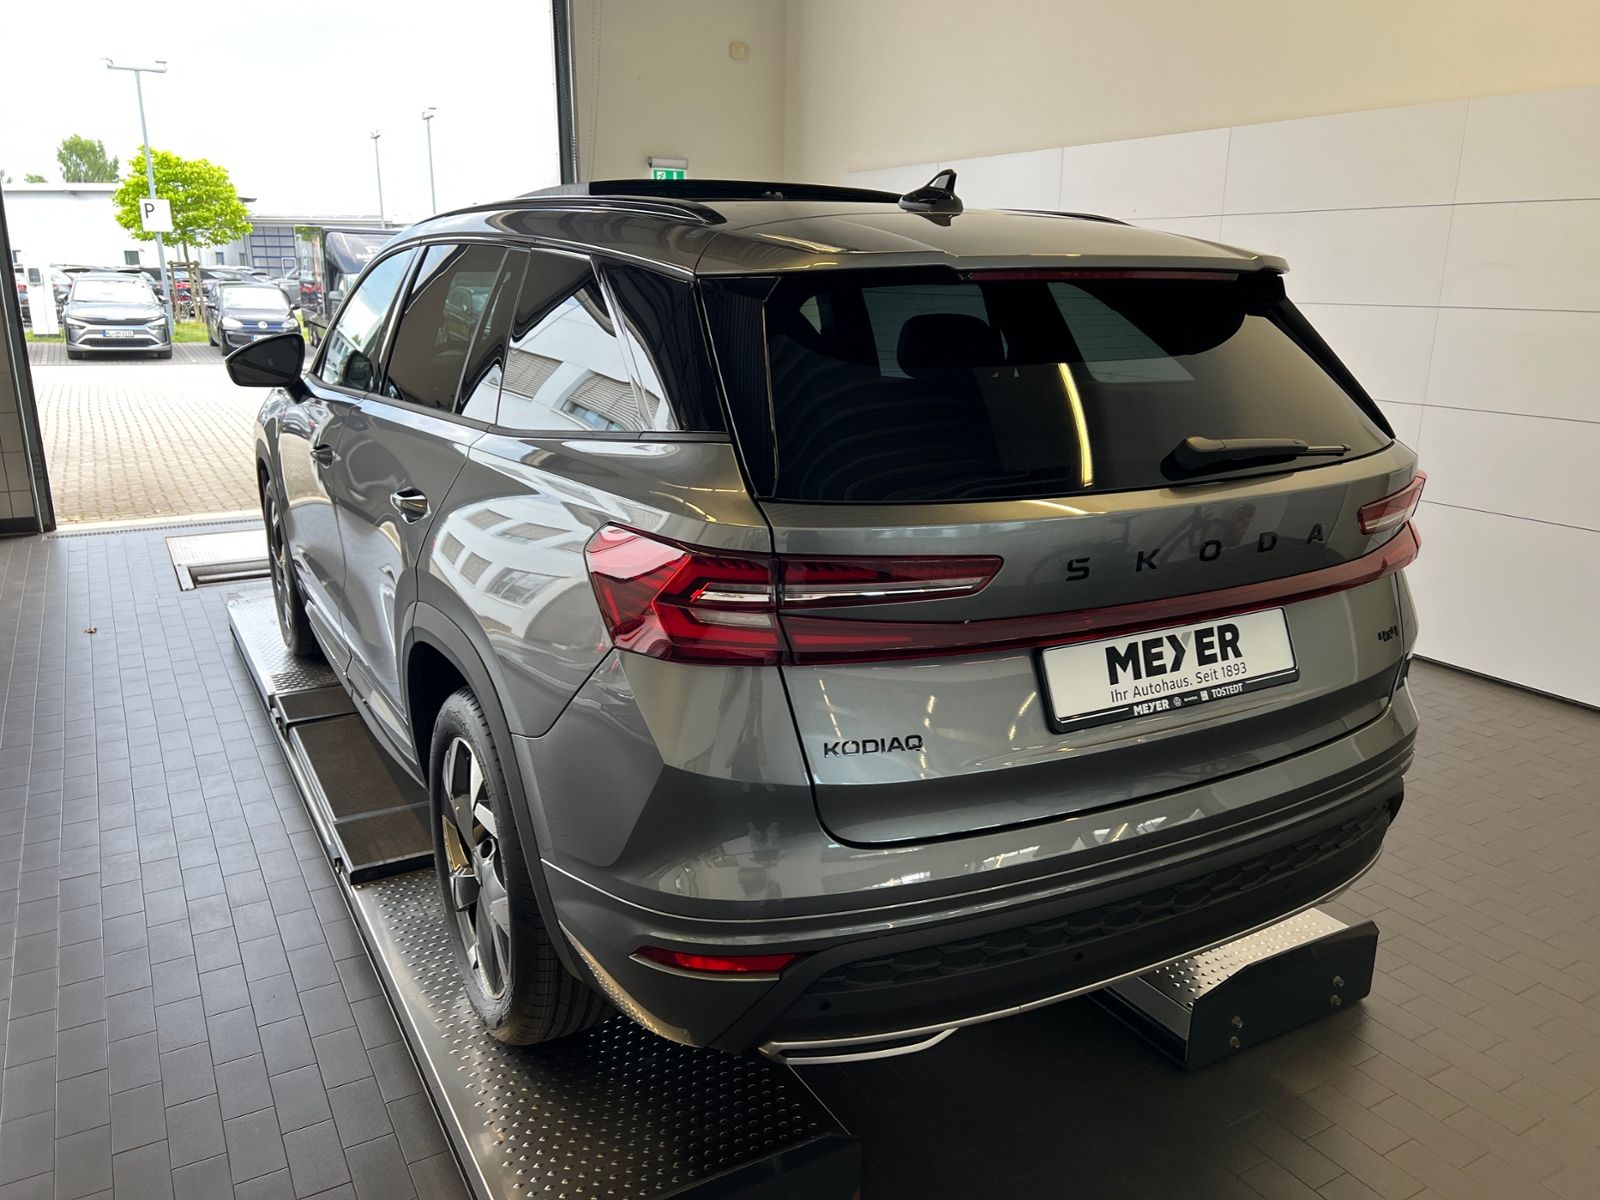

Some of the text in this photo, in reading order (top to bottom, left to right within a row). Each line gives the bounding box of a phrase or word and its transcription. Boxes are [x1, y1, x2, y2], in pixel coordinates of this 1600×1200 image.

[144, 203, 155, 219] P
[1065, 523, 1324, 581] SKODA
[1105, 623, 1243, 685] MEYER
[1111, 689, 1128, 703] Ihr
[1133, 677, 1193, 699] Autohaus.
[1196, 667, 1218, 684] Seit
[1222, 661, 1247, 678] 1893
[1133, 683, 1243, 716] MEYER TOSTEDT
[824, 734, 924, 758] KODIAQ
